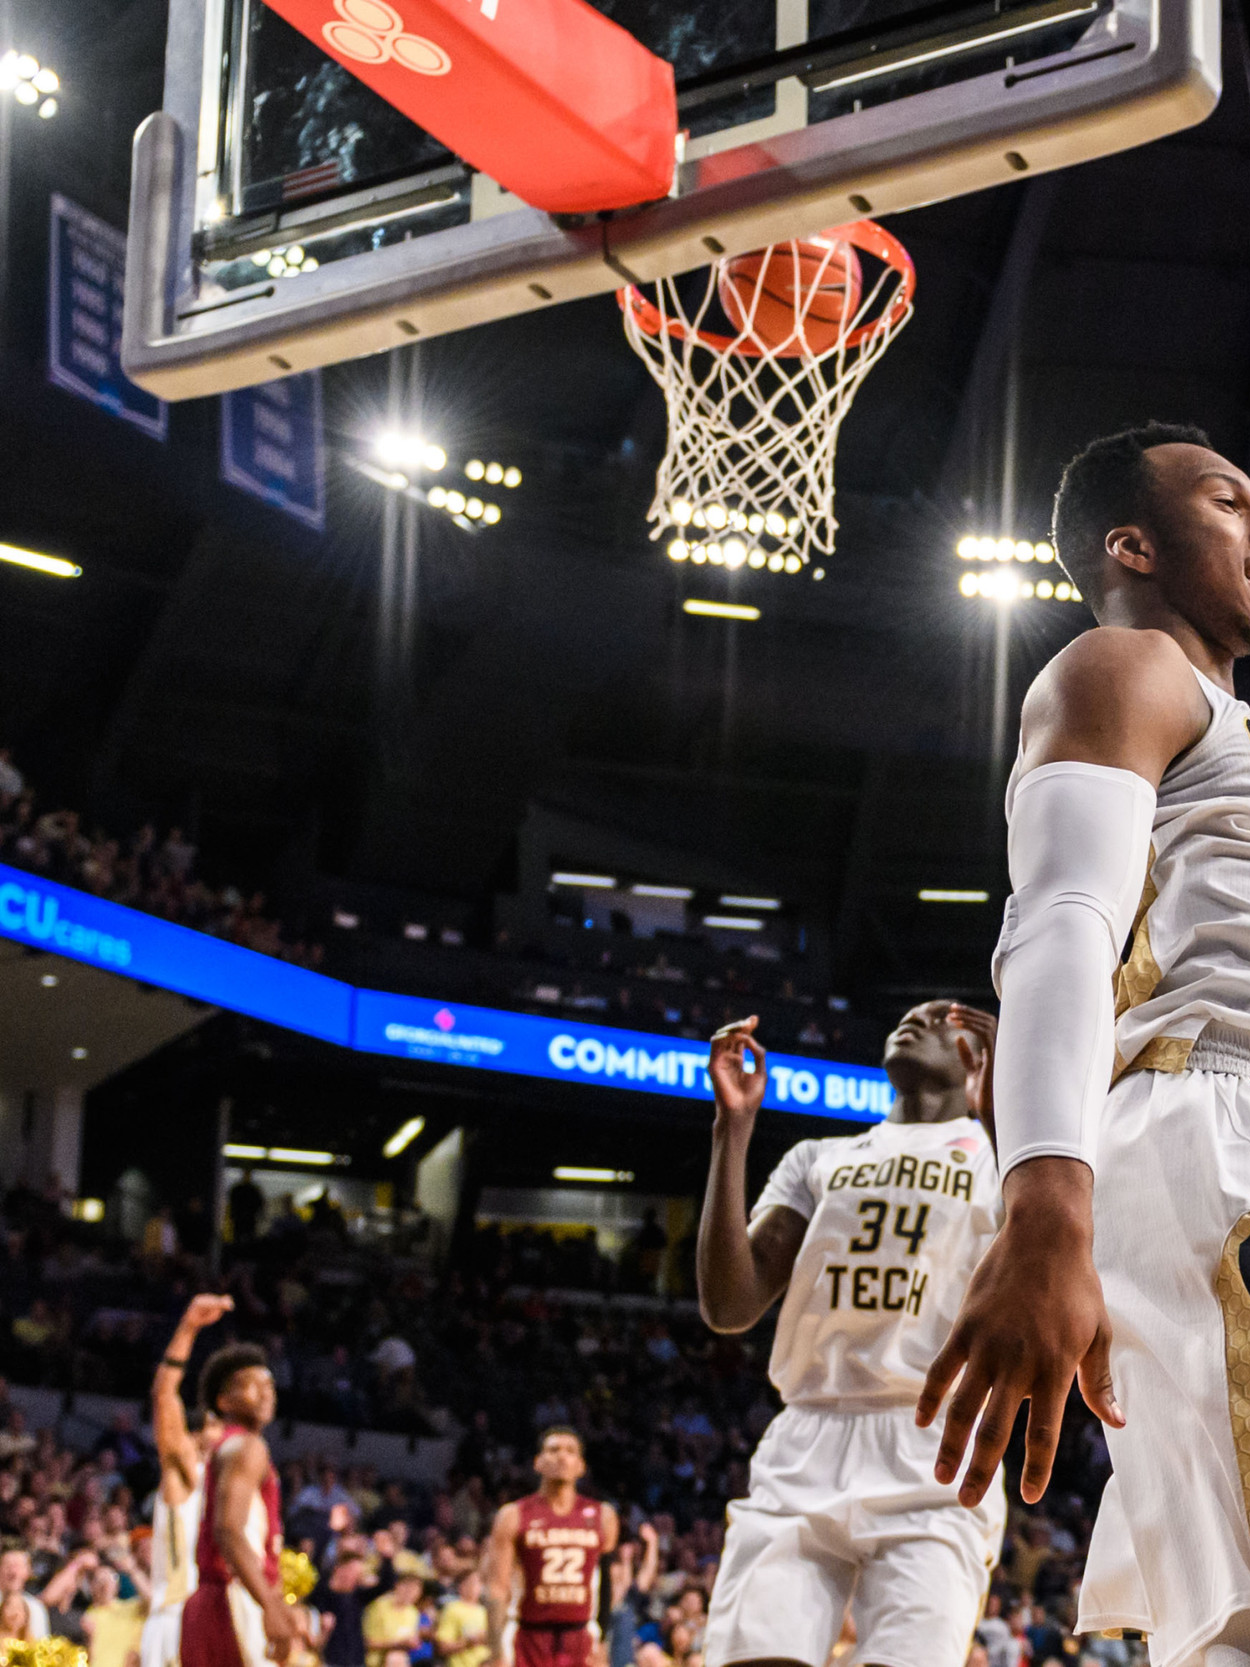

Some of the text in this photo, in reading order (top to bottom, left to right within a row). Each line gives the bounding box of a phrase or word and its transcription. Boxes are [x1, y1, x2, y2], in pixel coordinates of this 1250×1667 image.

[770, 1066, 820, 1104] TO
[824, 1073, 894, 1117] BUIL
[827, 1154, 973, 1202] GEORGIA
[849, 1199, 931, 1255] 34
[826, 1265, 928, 1316] TECH
[541, 1547, 587, 1585] 22
